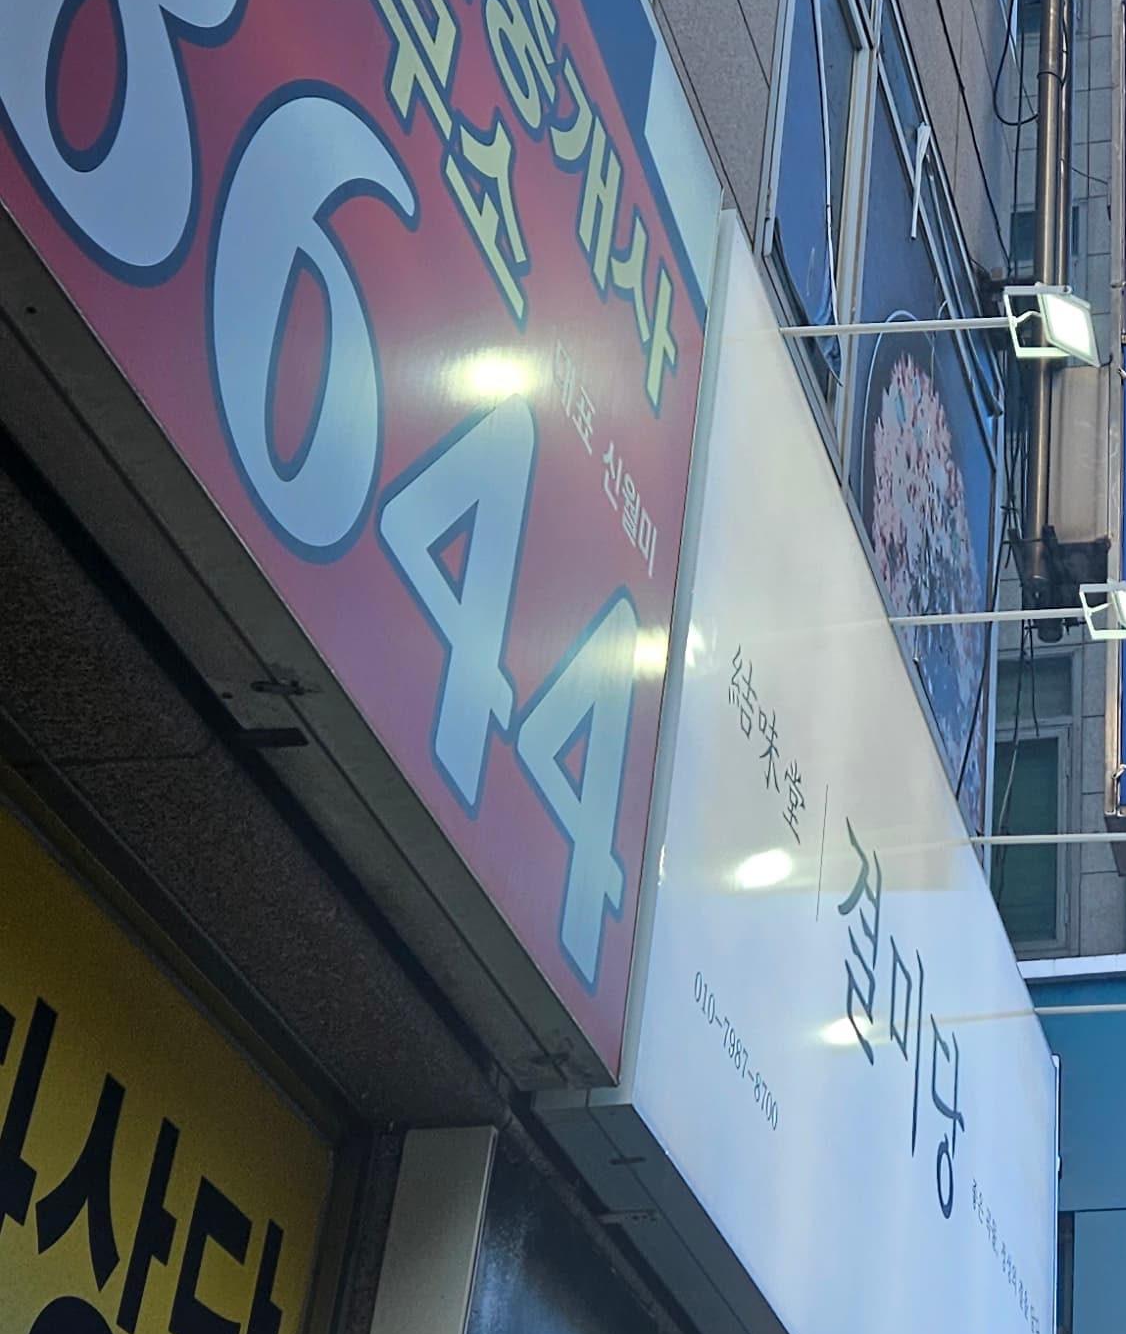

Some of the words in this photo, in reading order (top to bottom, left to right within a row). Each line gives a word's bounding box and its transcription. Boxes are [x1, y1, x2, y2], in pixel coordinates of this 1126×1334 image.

[603, 435, 660, 579] 신월미
[694, 970, 779, 1132] 010-7987-8700
[837, 816, 966, 1220] 결미당
